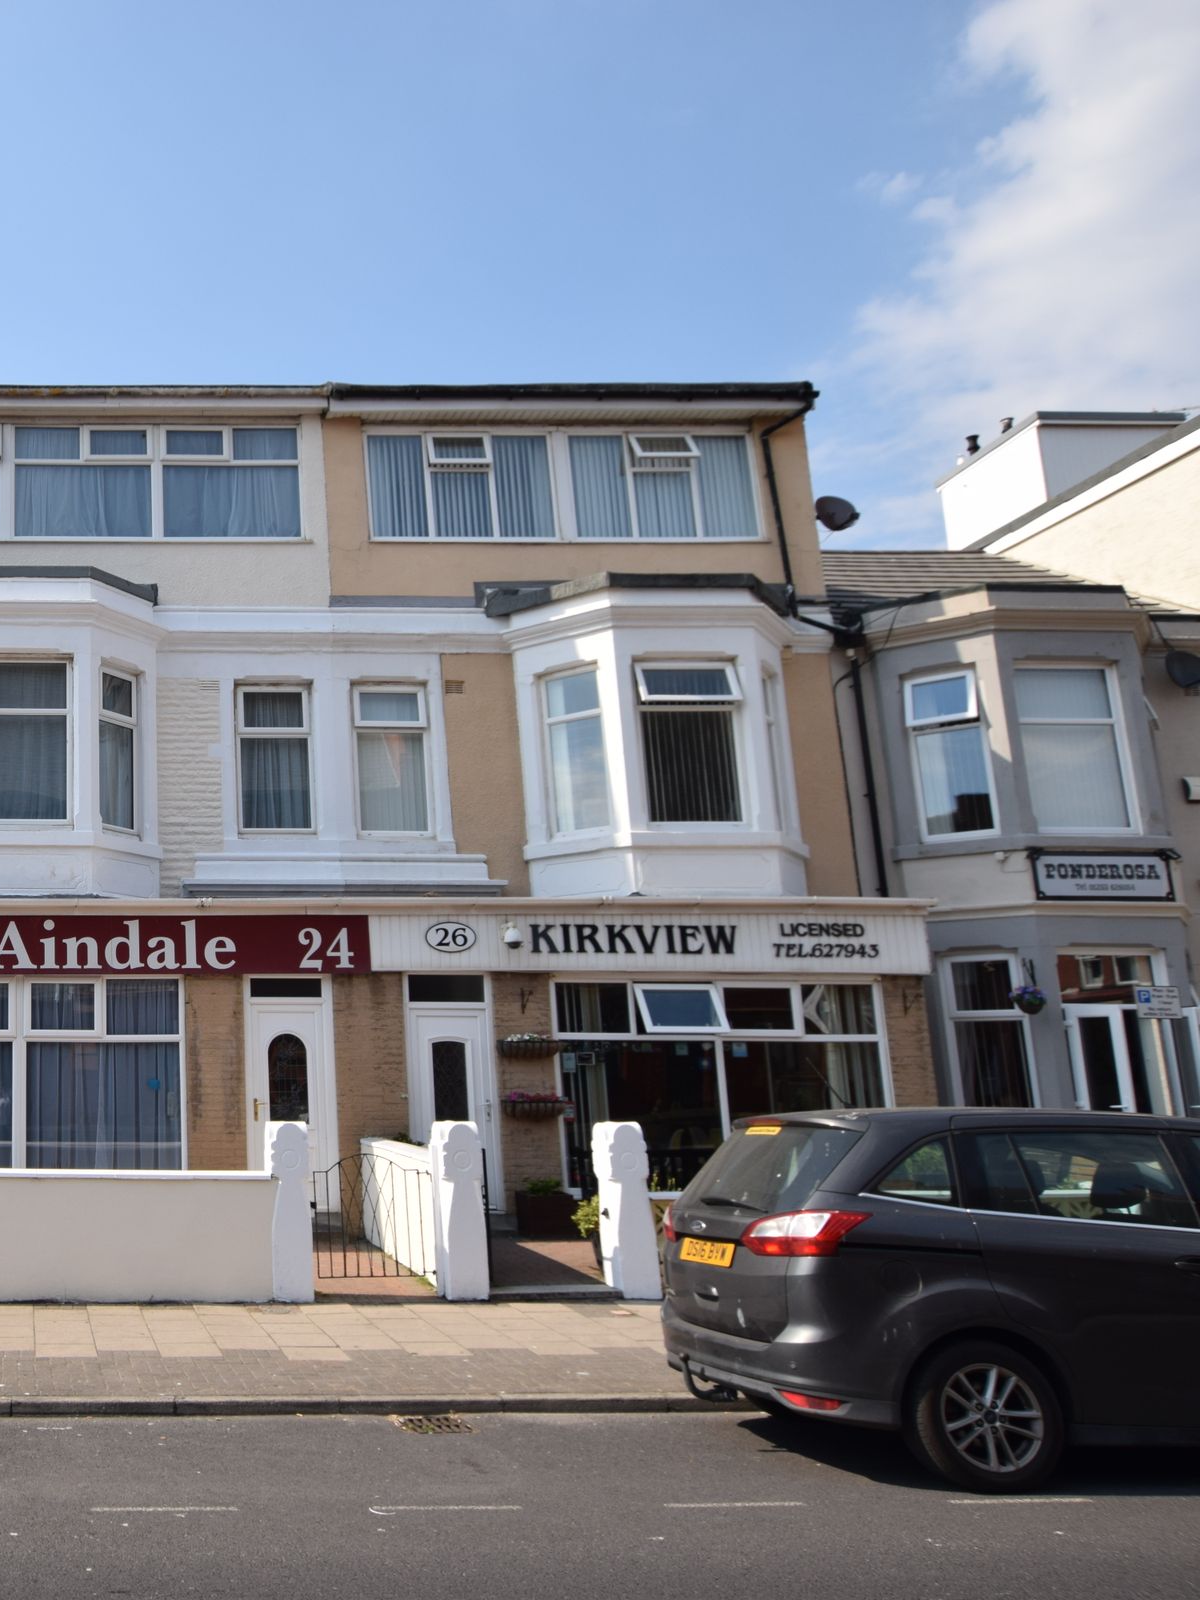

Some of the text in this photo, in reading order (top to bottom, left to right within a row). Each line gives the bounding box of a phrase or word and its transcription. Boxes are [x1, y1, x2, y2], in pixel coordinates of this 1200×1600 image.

[1044, 863, 1161, 880] PONDEROSA
[433, 927, 469, 949] 26
[529, 923, 738, 955] KIRKVIEW
[779, 923, 865, 938] LICENSED
[298, 927, 355, 972] 24
[773, 943, 880, 959] TEL.627943
